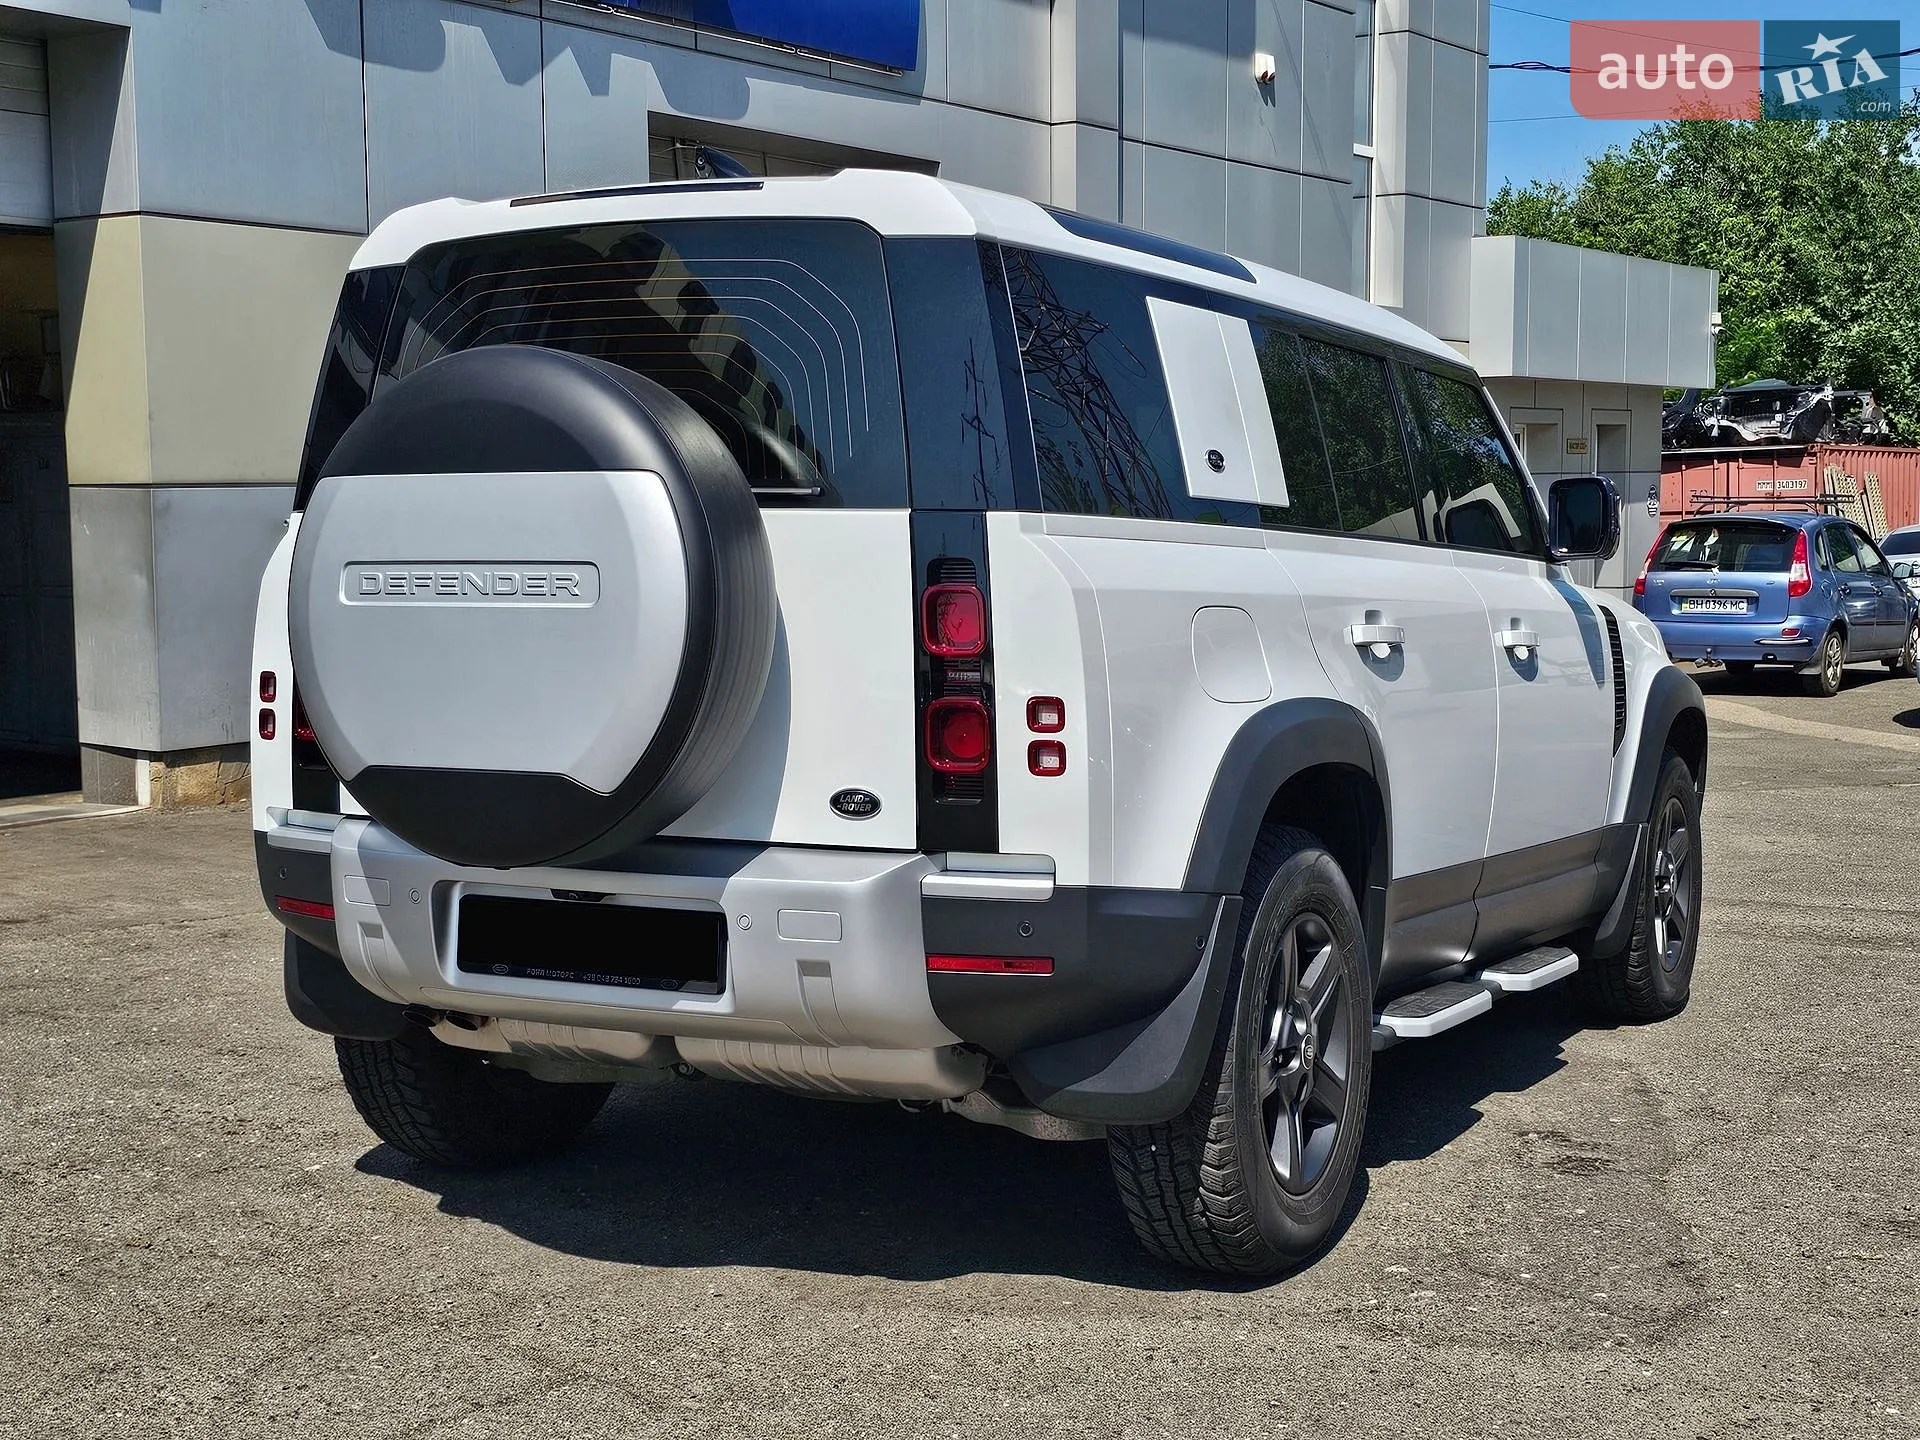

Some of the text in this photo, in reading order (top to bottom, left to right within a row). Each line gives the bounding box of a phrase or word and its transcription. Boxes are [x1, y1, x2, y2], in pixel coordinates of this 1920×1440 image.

[359, 571, 581, 597] DEFENDER
[1705, 600, 1728, 610] 0396
[1730, 600, 1745, 610] MC
